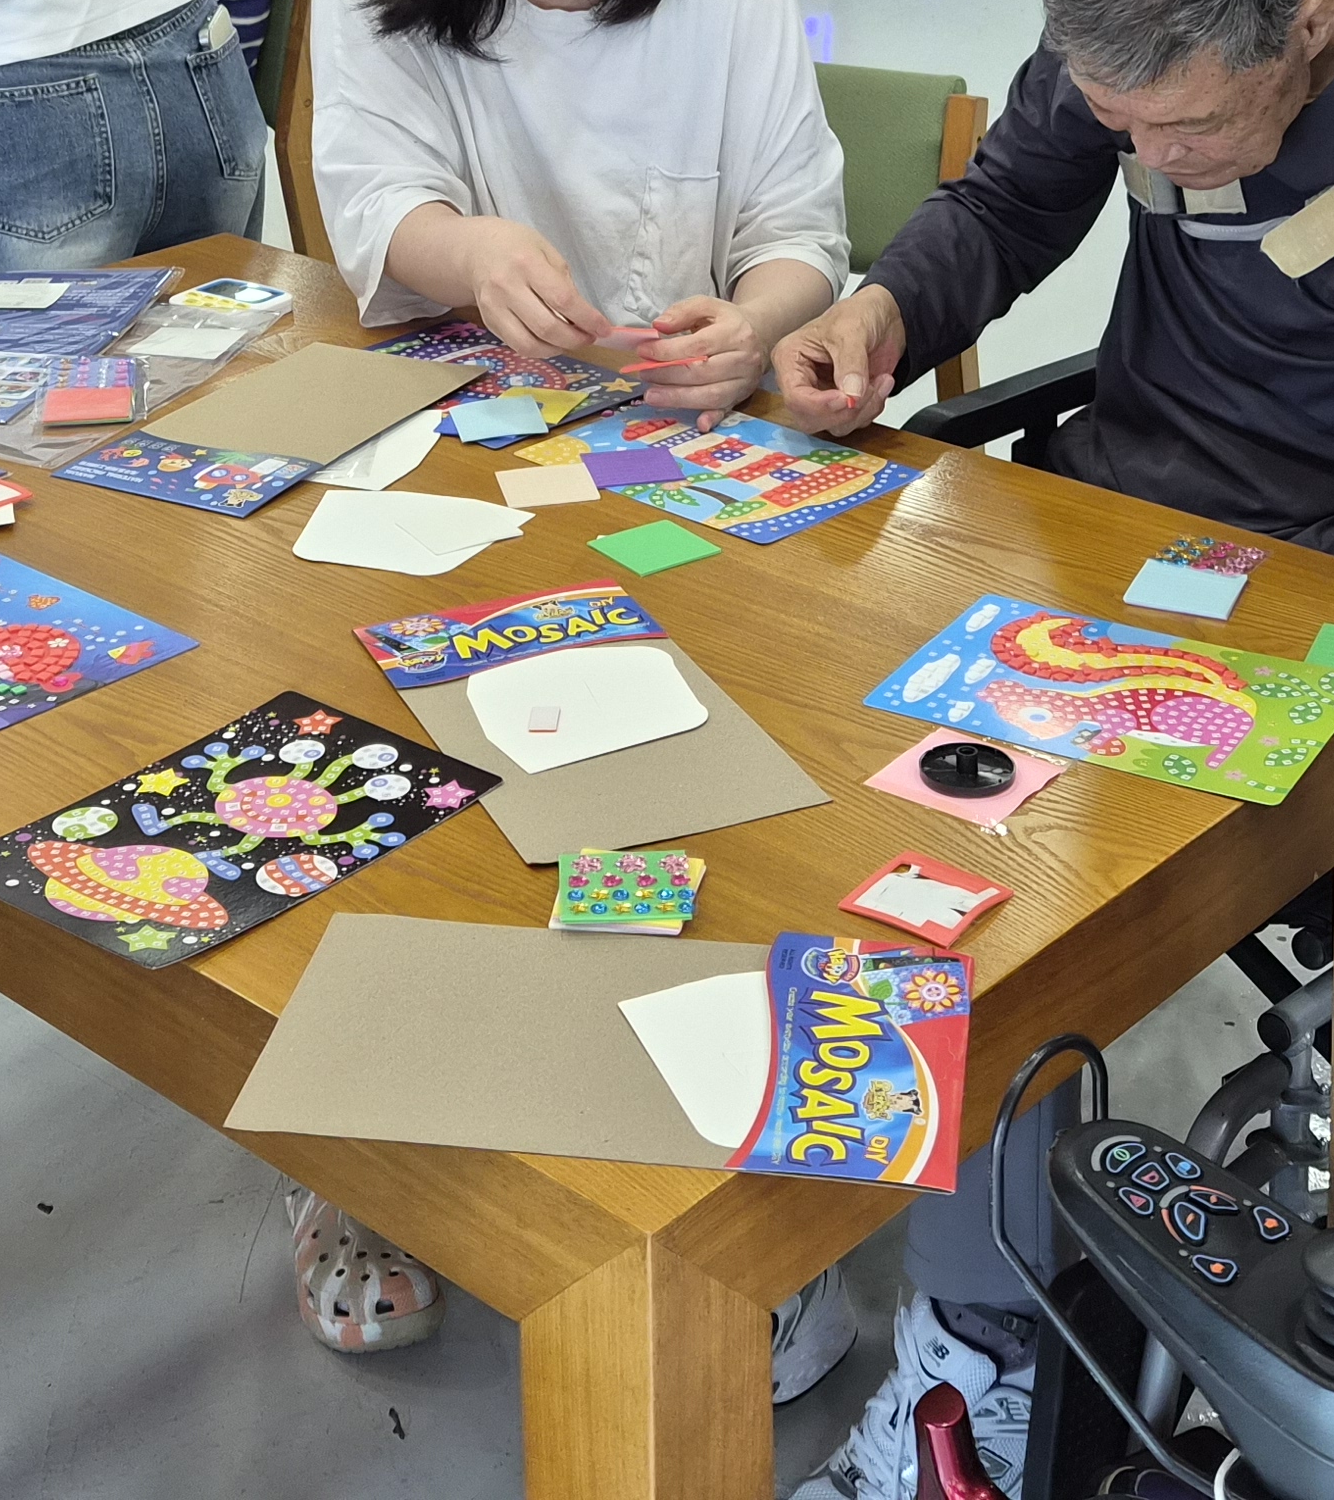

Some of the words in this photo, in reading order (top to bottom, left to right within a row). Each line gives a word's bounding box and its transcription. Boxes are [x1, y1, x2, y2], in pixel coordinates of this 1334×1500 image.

[452, 607, 640, 660] MOSAIC
[789, 989, 884, 1163] MOSAIC
[864, 1135, 891, 1166] DIY
